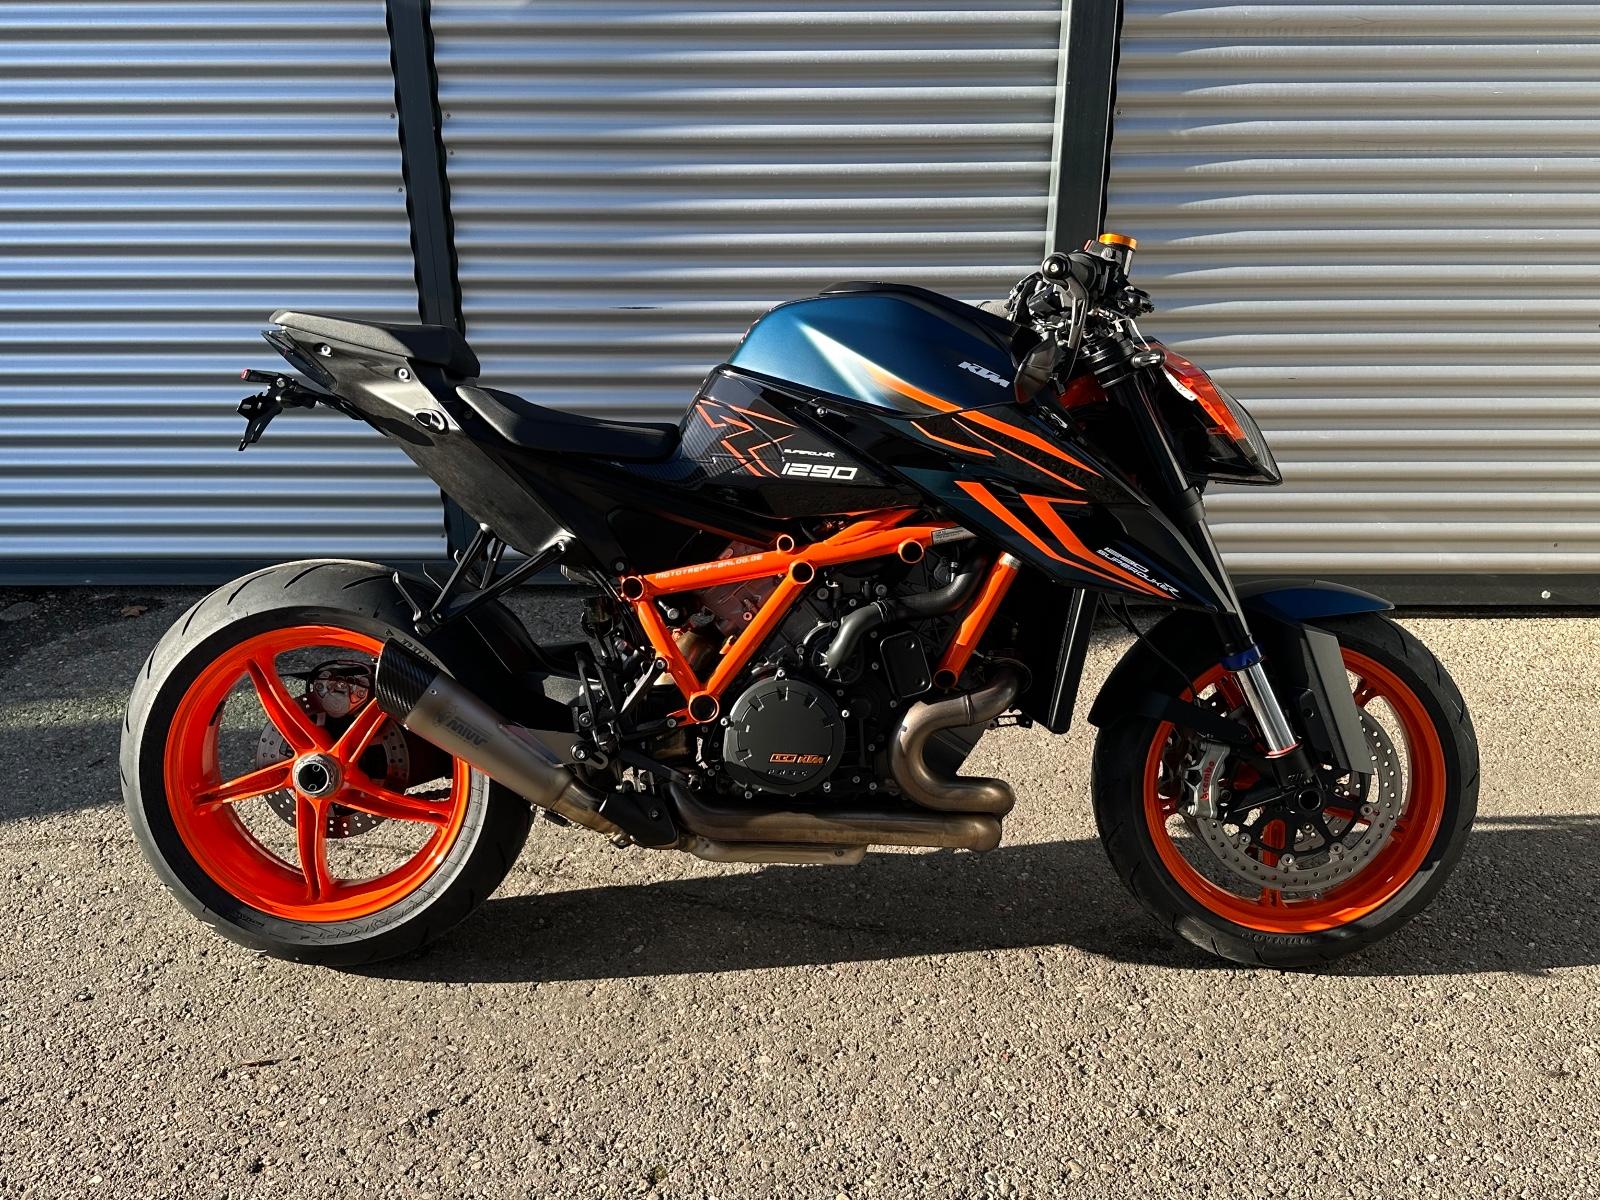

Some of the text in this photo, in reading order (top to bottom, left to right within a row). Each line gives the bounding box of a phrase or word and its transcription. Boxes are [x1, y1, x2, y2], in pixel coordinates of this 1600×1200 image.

[957, 361, 1010, 388] KTM
[781, 462, 858, 481] 1290
[1200, 761, 1215, 801] brembo
